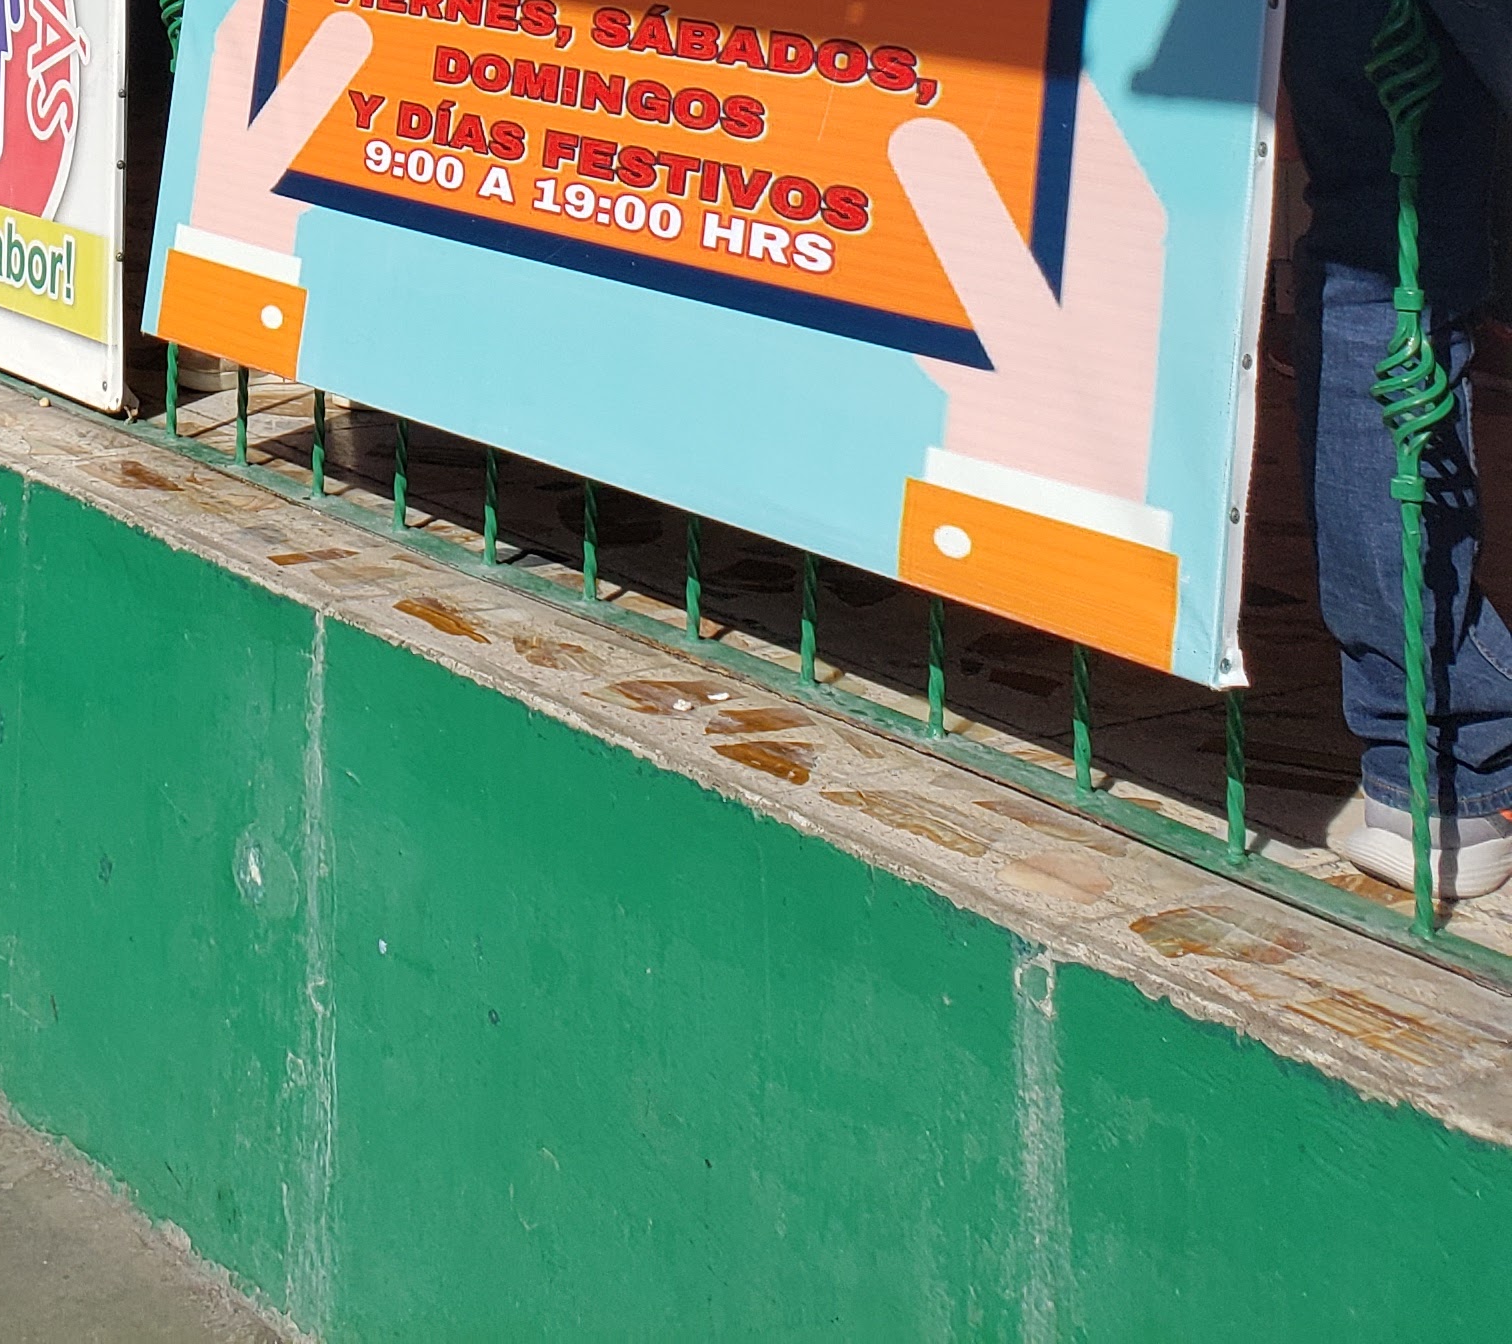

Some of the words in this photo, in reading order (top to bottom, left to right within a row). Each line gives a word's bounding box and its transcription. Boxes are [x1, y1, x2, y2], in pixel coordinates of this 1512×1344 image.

[432, 44, 766, 141] DOMINGOS
[591, 2, 940, 106] SÁBADOS,
[346, 88, 380, 133] Y
[395, 98, 528, 171] DÍAS
[542, 127, 872, 234] FESTIVOS
[363, 138, 468, 192] 9:00
[474, 159, 517, 205] A
[532, 172, 684, 239] 19:00
[701, 209, 837, 276] HRS
